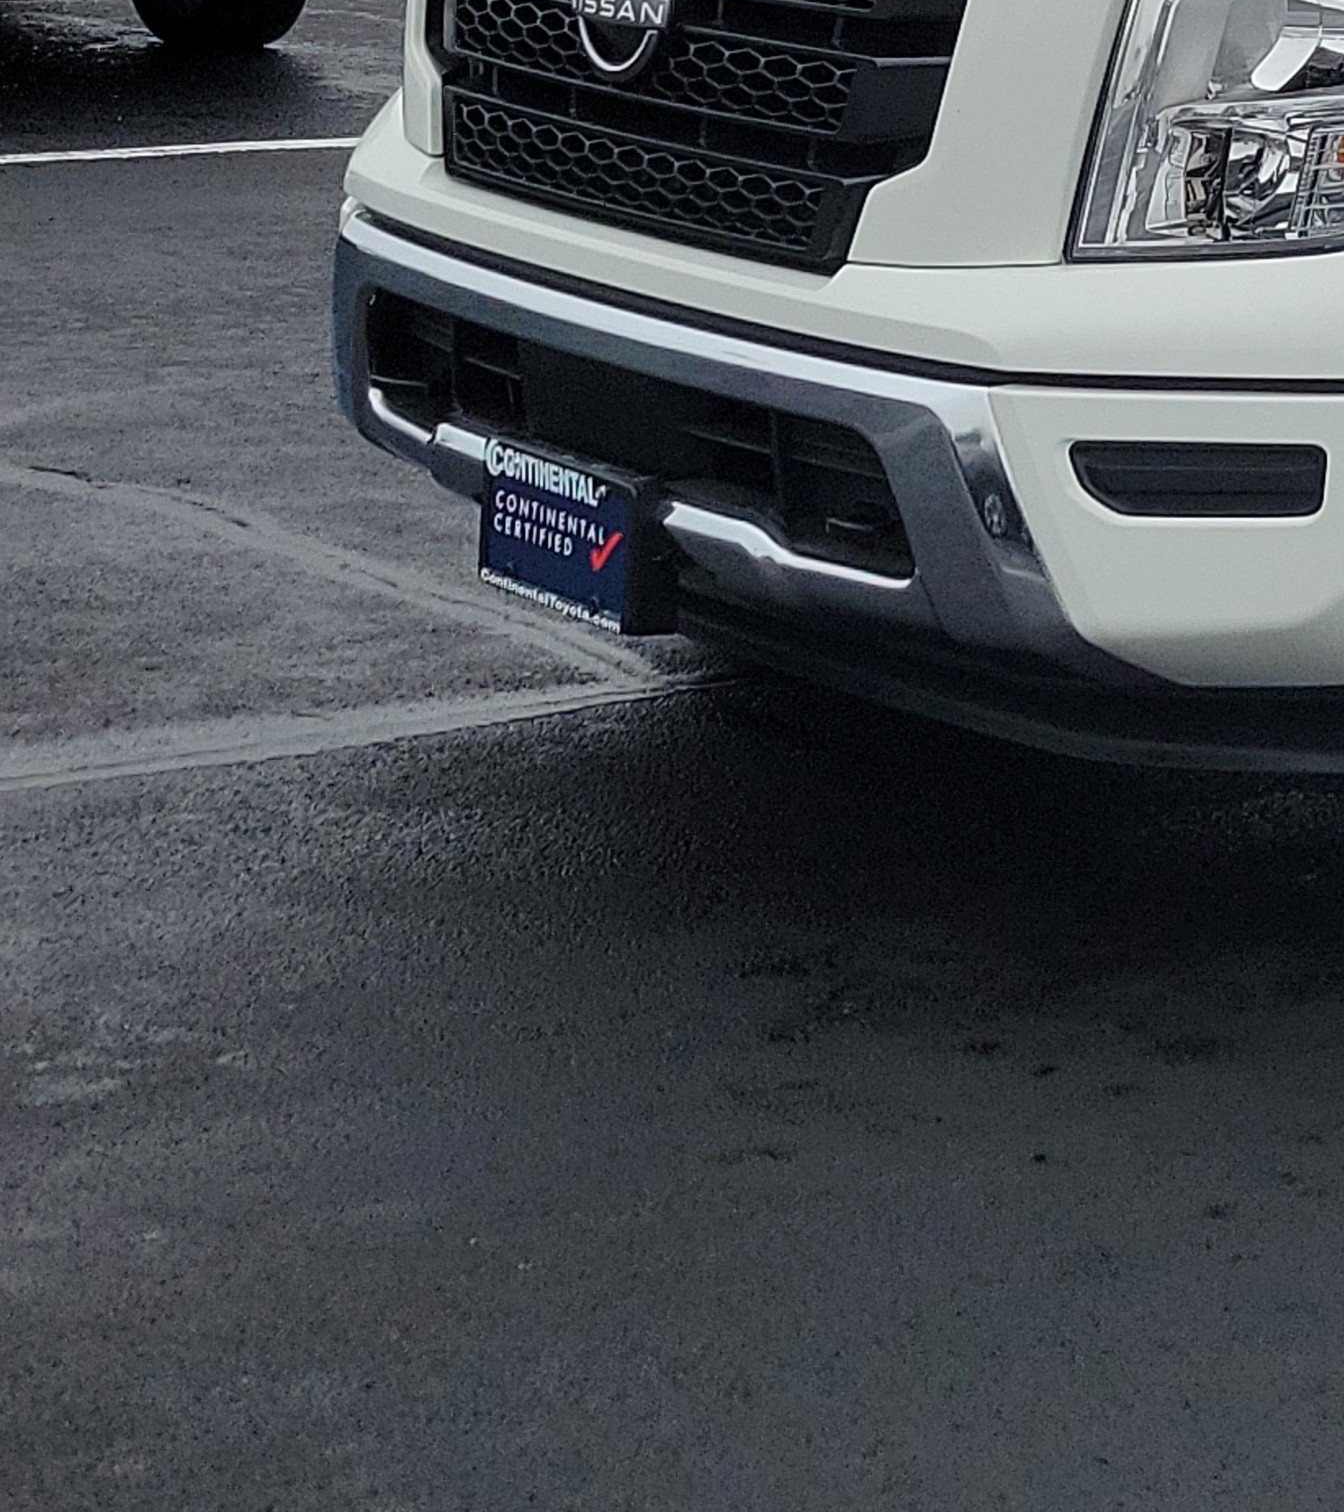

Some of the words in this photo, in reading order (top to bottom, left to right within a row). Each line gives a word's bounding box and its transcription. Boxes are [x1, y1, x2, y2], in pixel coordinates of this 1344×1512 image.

[485, 438, 599, 508] CONTINENTAL
[493, 512, 574, 556] CERTIFIED
[495, 489, 604, 546] CONTINENTAL
[480, 567, 621, 635] ContinentalToyota.com
